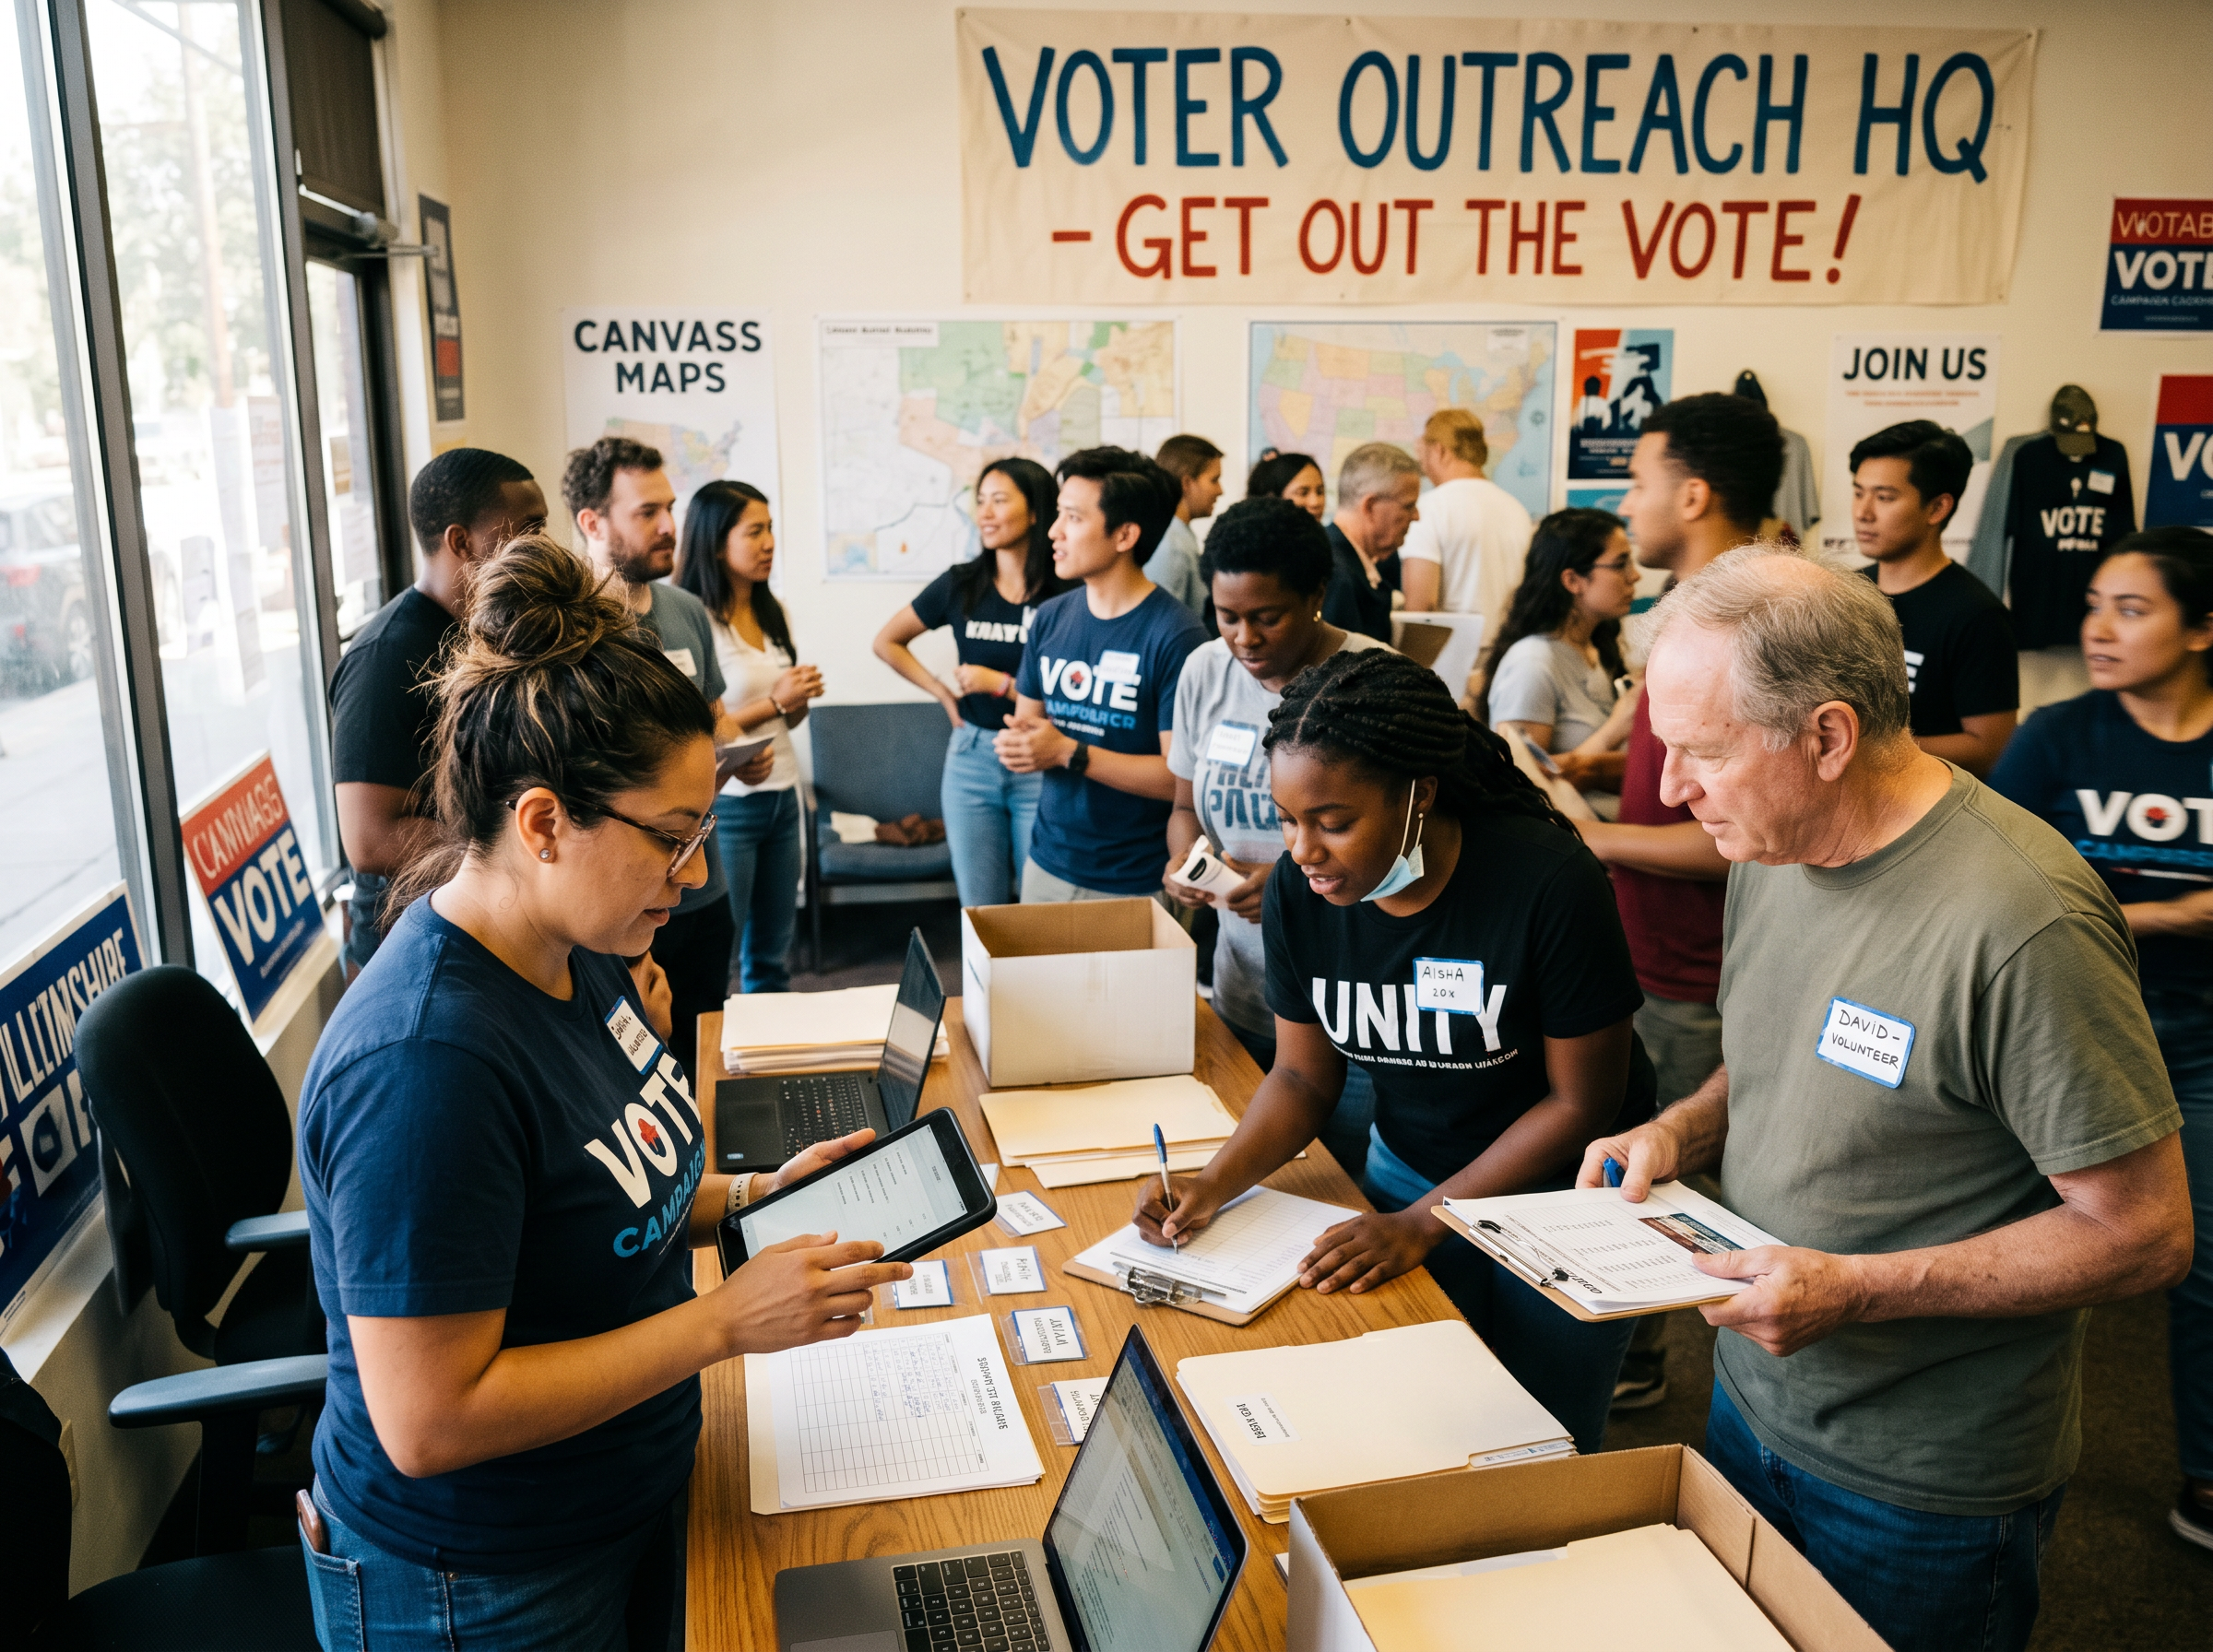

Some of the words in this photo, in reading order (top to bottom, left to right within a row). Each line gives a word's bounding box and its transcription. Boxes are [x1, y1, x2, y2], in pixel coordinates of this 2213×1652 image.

[981, 45, 1289, 169] VOTER
[1338, 50, 1809, 176] OUTREACH
[1853, 50, 1995, 184] HQ
[1116, 193, 1271, 279] GET
[1298, 197, 1435, 276] OUT
[1465, 198, 1587, 277] THE
[1621, 193, 1862, 286] VOTE!
[574, 320, 763, 353] CANVASS
[616, 361, 727, 394] MAPS
[1842, 347, 1928, 381] JOIN
[1942, 347, 1987, 381] US
[2040, 504, 2107, 538] VOTE
[213, 828, 313, 968] VOTE
[1421, 965, 1464, 983] AISHA
[1832, 1032, 1899, 1070] VOLUNTEER
